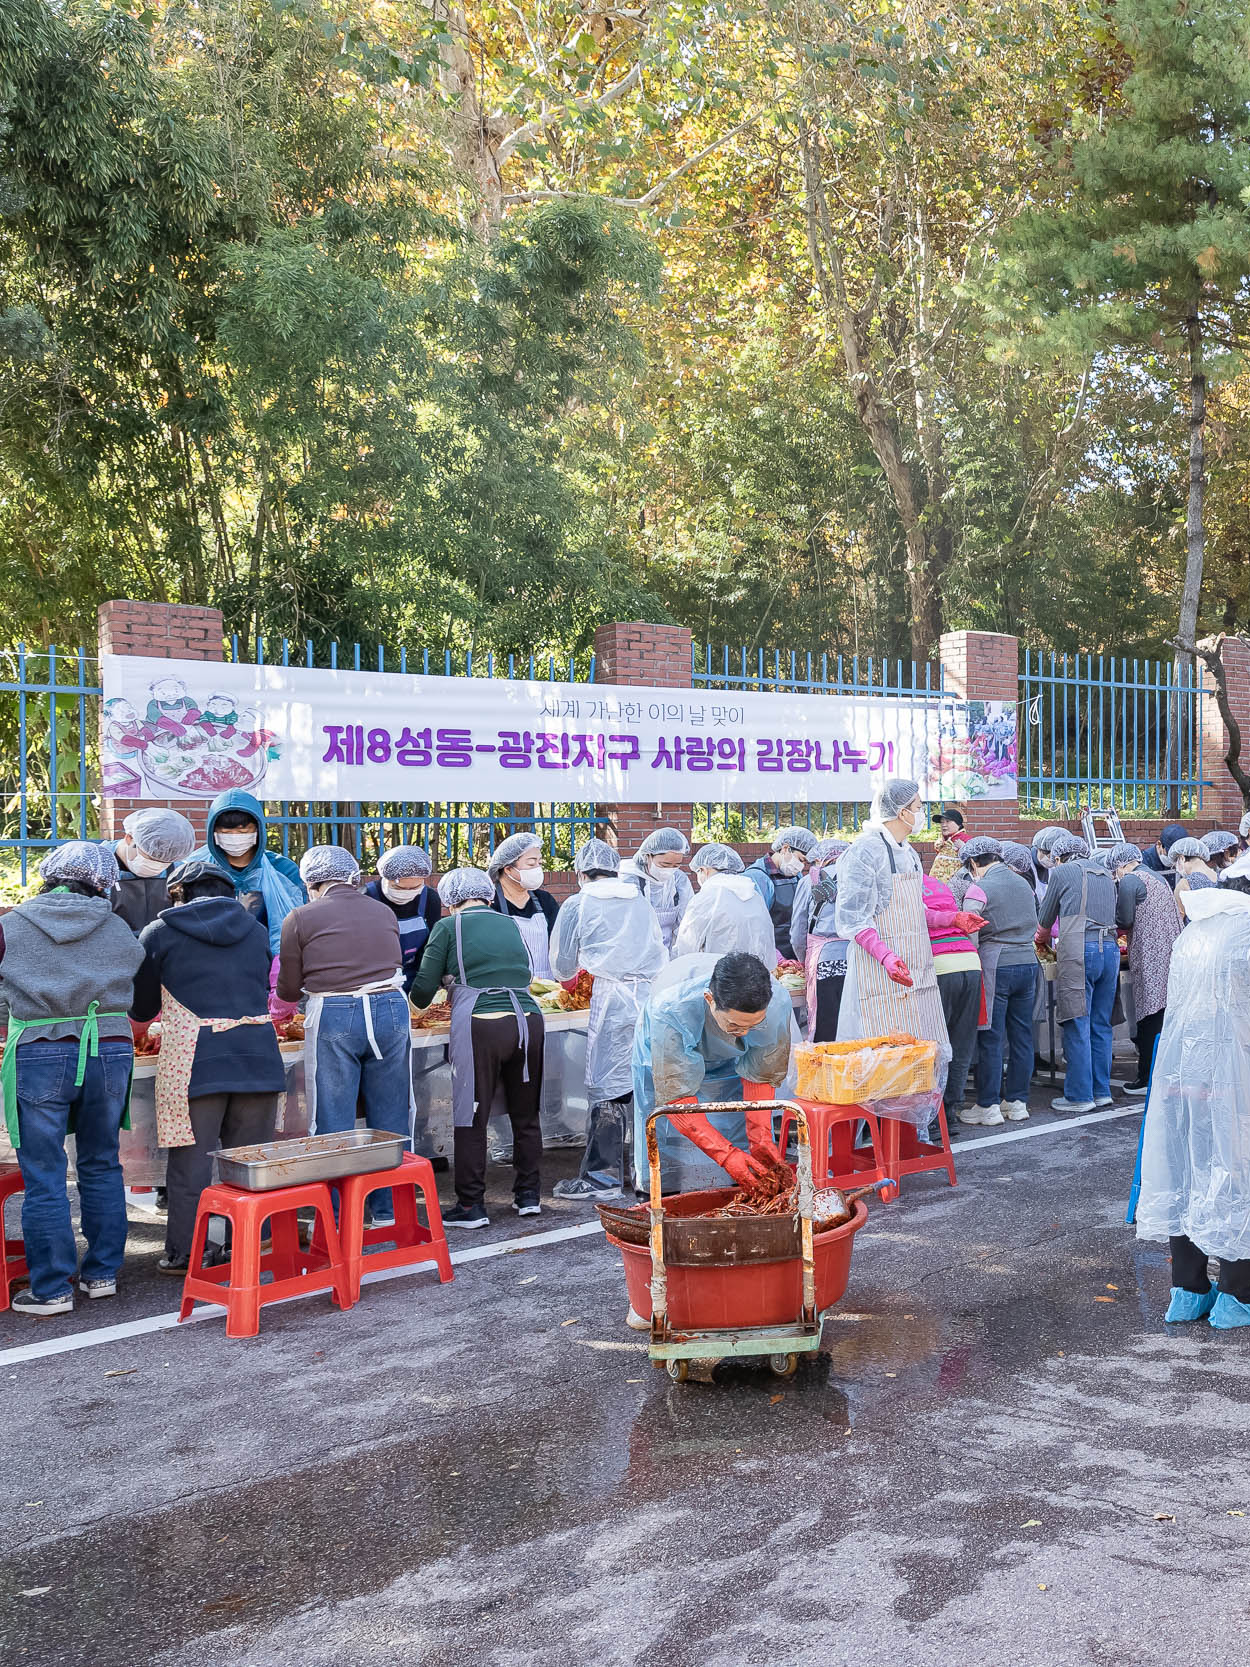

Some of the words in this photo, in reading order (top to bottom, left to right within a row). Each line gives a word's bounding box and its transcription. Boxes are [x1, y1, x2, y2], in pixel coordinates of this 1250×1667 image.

[539, 699, 580, 719] 세계
[585, 701, 643, 724] 가난한
[648, 703, 684, 723] 이의
[689, 705, 707, 727] 날
[711, 706, 745, 727] 맞이
[322, 724, 641, 771] 제8성동-광진지구
[651, 735, 746, 772] 사랑의
[756, 738, 894, 773] 김장나누기
